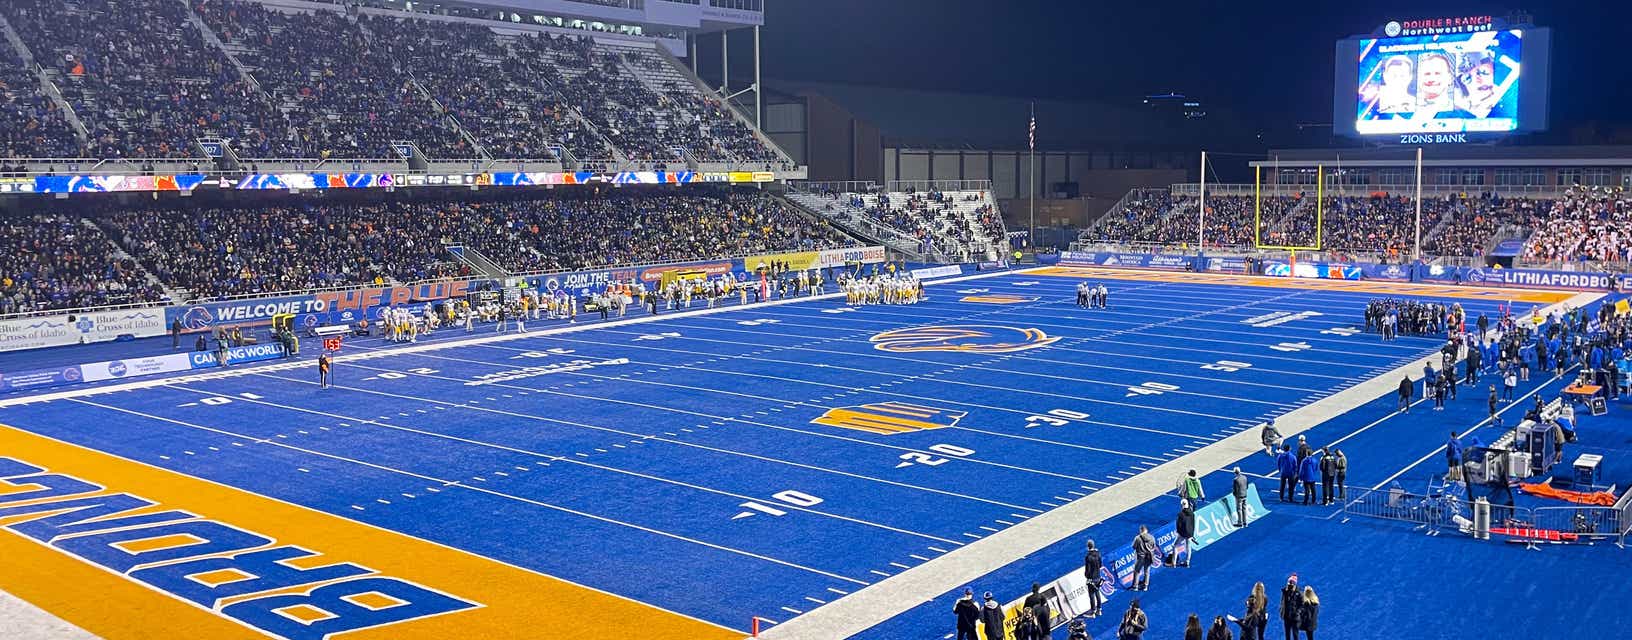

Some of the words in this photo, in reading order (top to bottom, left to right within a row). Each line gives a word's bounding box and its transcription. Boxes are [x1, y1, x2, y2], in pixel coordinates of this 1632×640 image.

[1403, 19, 1442, 28] DOUBLE
[1446, 18, 1452, 26] R
[1455, 16, 1491, 26] RANCH
[1403, 25, 1462, 36] Northwest
[1466, 22, 1492, 32] Beef
[1400, 135, 1433, 144] ZIONS
[1435, 134, 1467, 143] BANK
[564, 273, 590, 285] JOIN
[590, 271, 609, 282] THE
[612, 270, 638, 281] TEAM
[217, 301, 300, 321] WELCOME
[304, 299, 326, 313] TO
[315, 287, 383, 313] THE
[391, 280, 469, 307] BLUE
[96, 314, 118, 323] Blue
[96, 324, 123, 332] Cross
[135, 319, 159, 328] Idaho
[41, 329, 66, 338] Idaho
[245, 344, 285, 358] WORLD
[1032, 408, 1090, 427] 30
[899, 443, 976, 467] 20
[740, 489, 824, 516] 10
